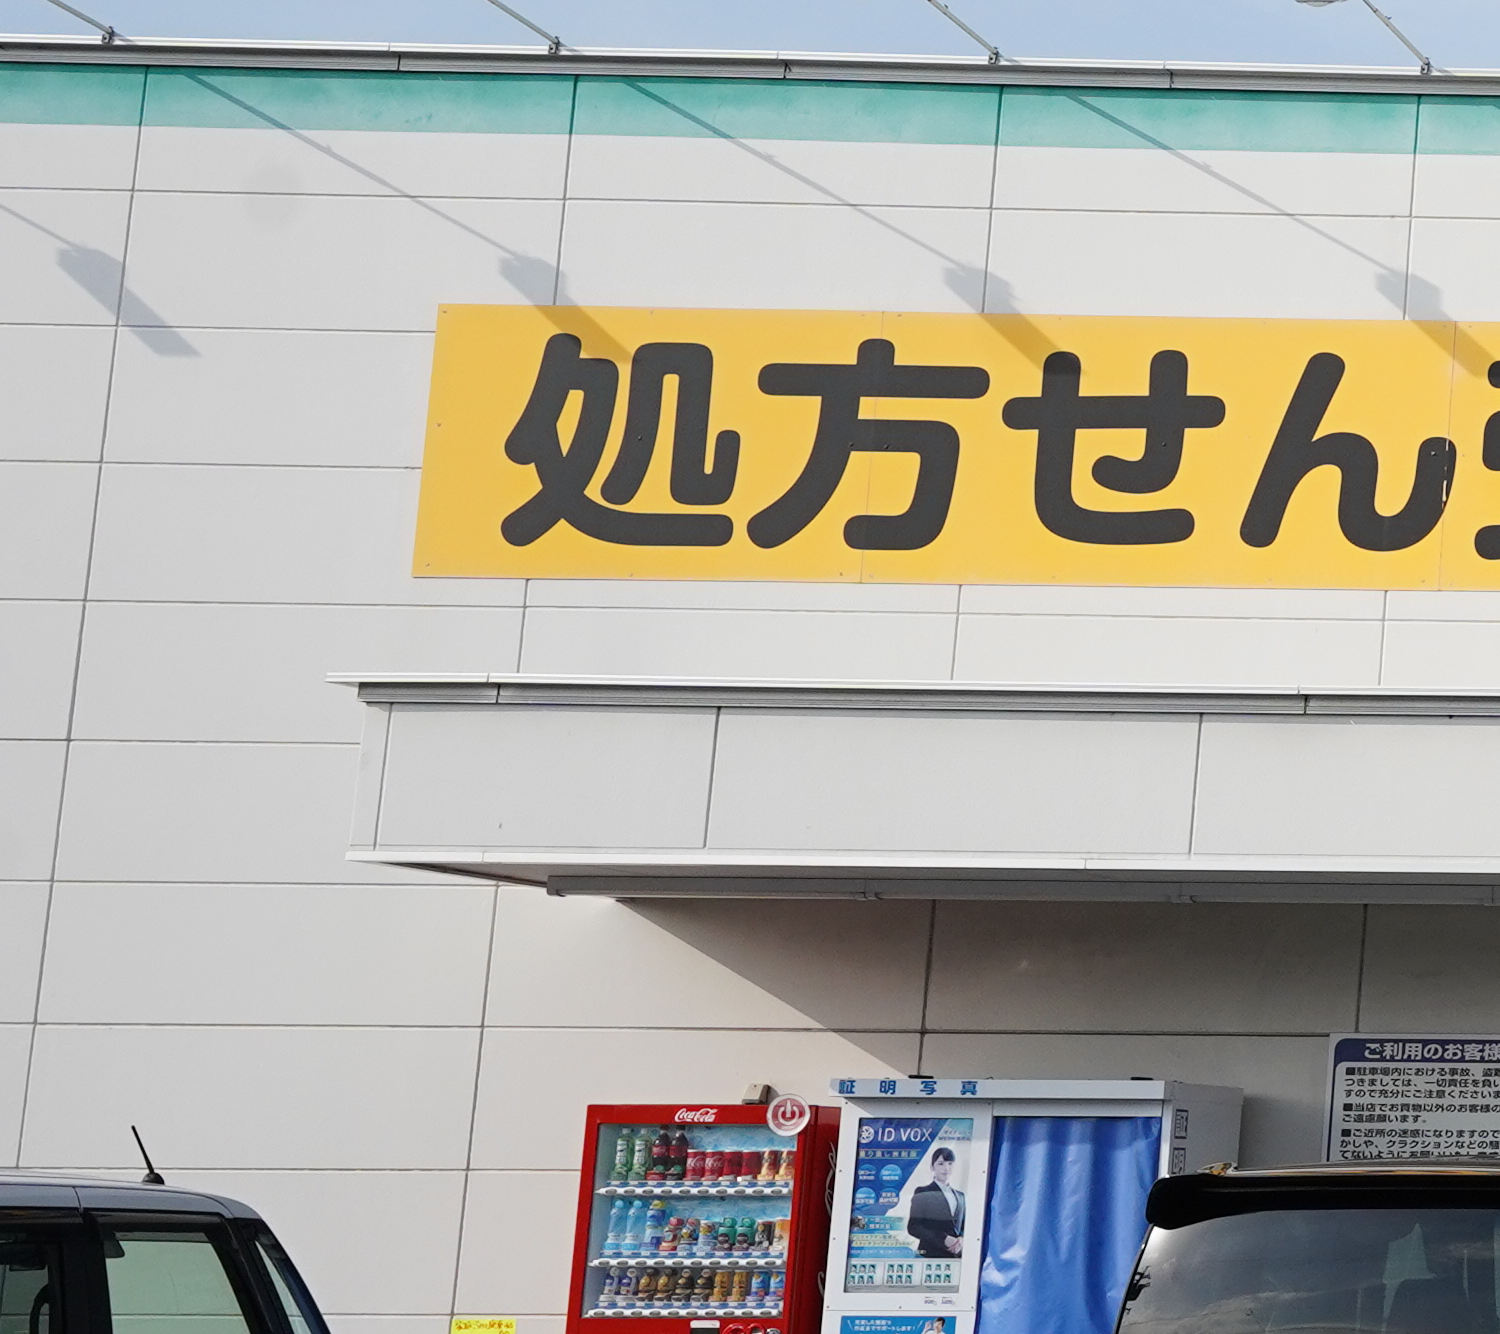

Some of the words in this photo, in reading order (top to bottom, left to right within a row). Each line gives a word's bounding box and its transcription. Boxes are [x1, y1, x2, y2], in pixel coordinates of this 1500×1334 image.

[838, 1080, 978, 1095] 証明写真
[878, 1127, 895, 1142] ID
[900, 1127, 932, 1142] VOX
